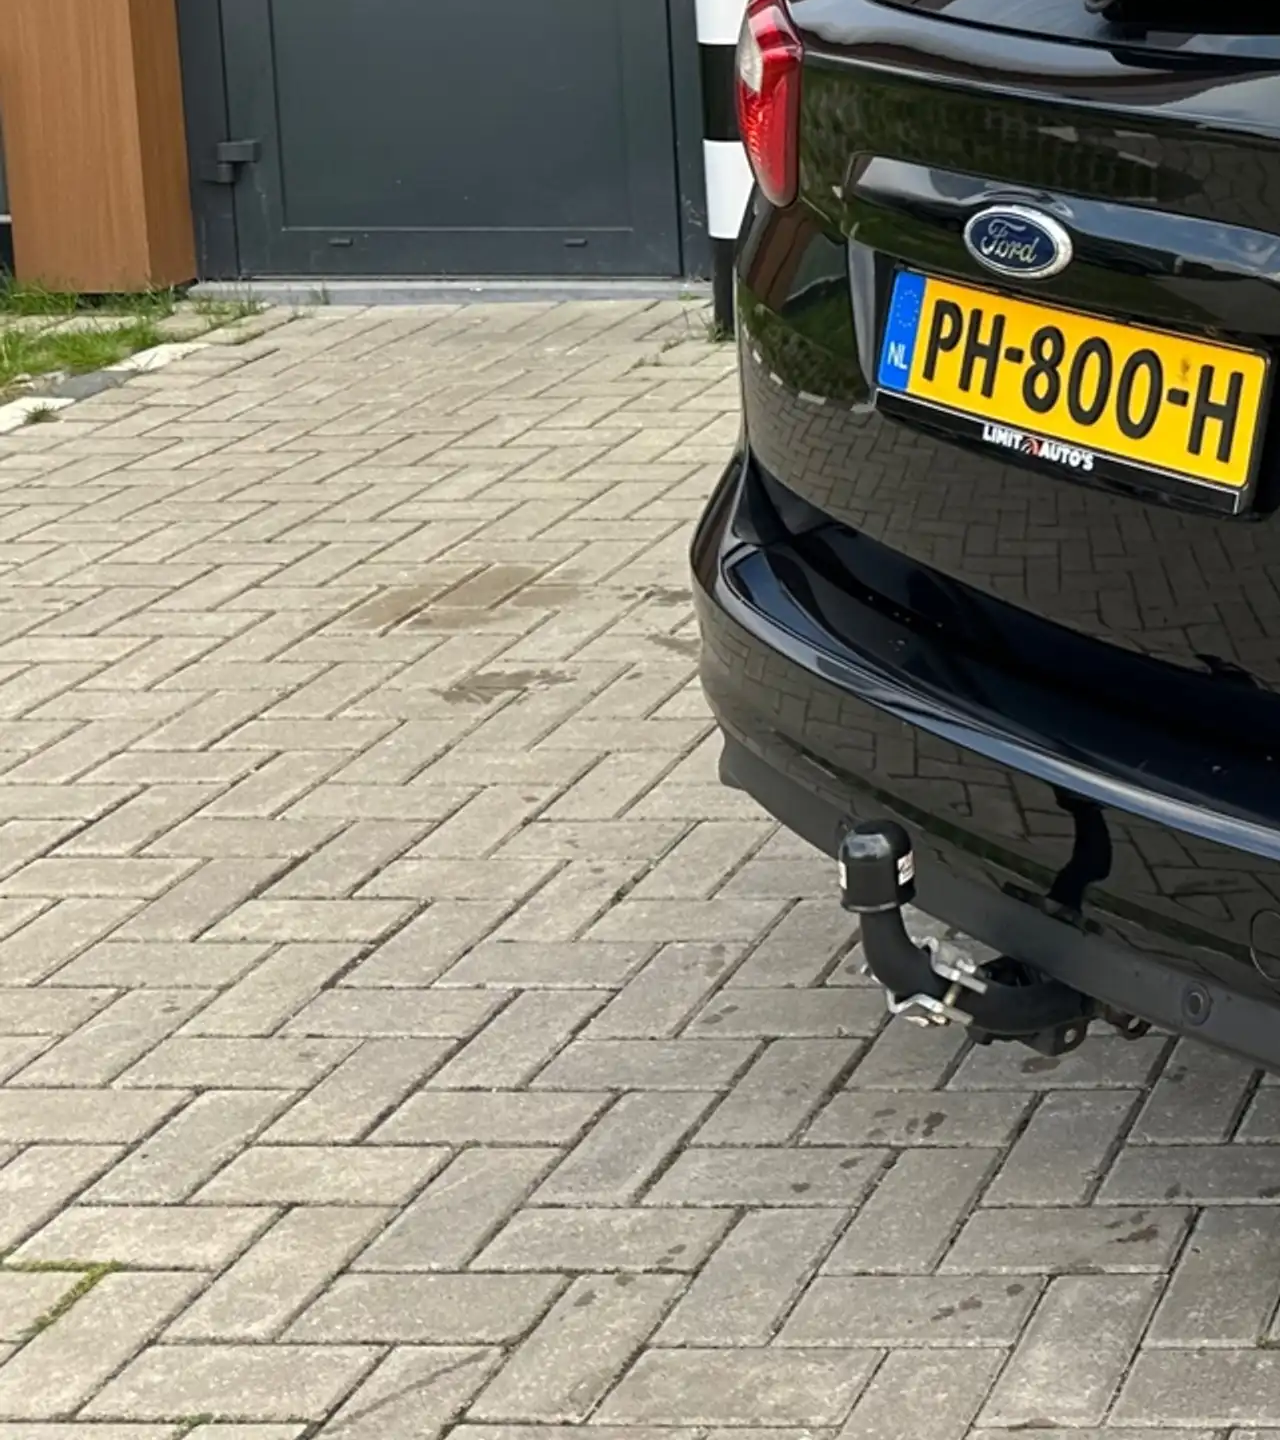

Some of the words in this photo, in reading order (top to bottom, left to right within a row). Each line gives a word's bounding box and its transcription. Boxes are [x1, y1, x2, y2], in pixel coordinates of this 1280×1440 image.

[980, 217, 1040, 265] Ford
[887, 339, 909, 371] NL
[922, 298, 1244, 464] PH-800-H
[981, 423, 1023, 450] LIMIT
[1037, 439, 1095, 472] AUTO'S
